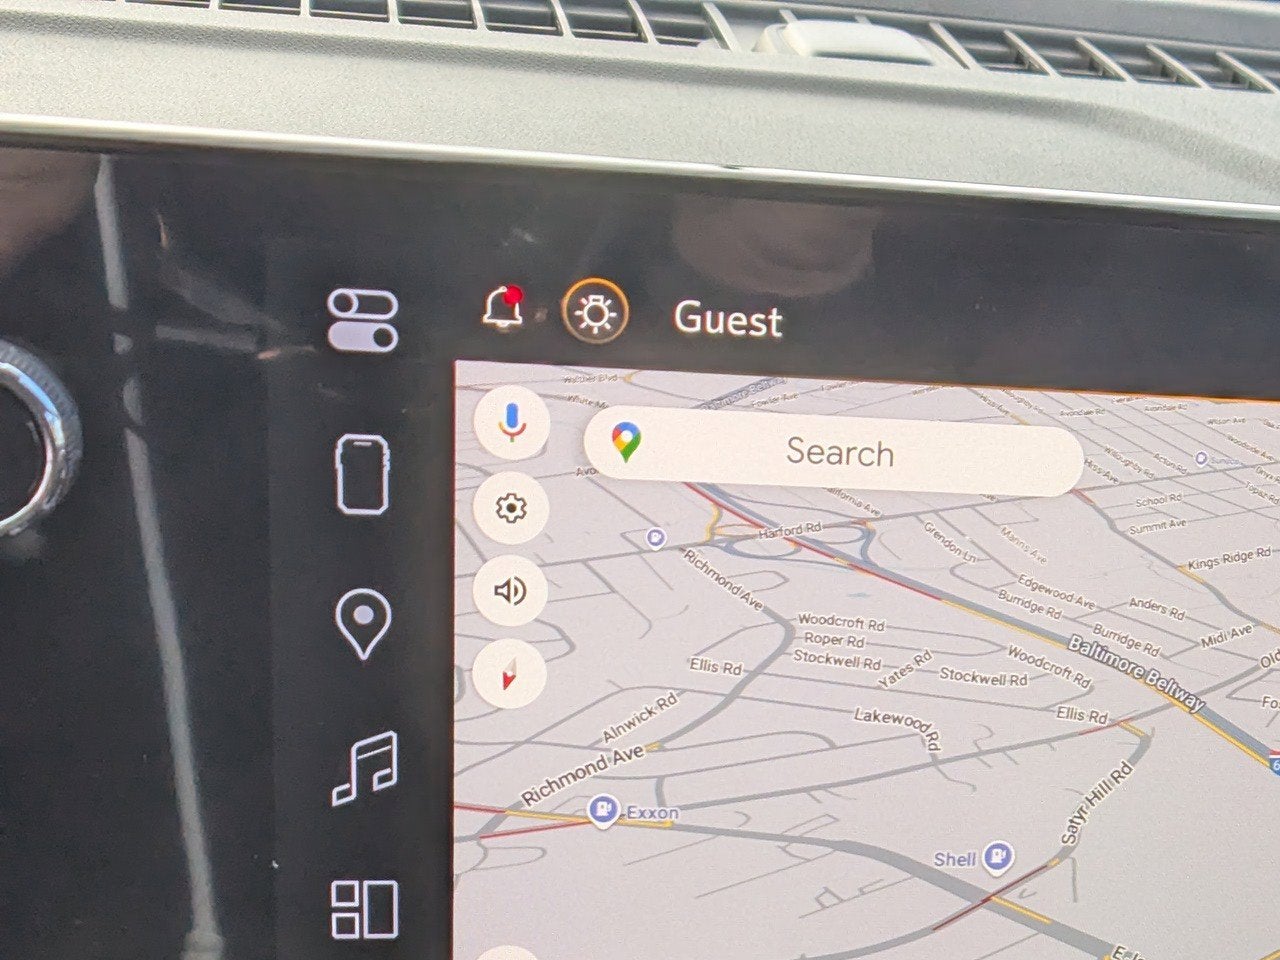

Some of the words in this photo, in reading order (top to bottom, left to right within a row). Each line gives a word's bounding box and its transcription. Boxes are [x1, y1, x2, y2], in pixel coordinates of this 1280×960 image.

[674, 299, 783, 337] Guest
[787, 436, 893, 467] Search
[1143, 469, 1154, 479] Rd
[1176, 466, 1187, 475] Rd
[1136, 496, 1167, 507] School
[1170, 494, 1182, 502] Rd
[1269, 493, 1280, 505] Rd
[759, 524, 803, 539] Harford
[806, 522, 822, 532] Rd
[1130, 523, 1166, 535] Summit
[1169, 519, 1187, 528] Ave
[924, 522, 966, 556] Grendon
[964, 551, 976, 563] Ln
[1030, 549, 1047, 564] Ave
[1188, 559, 1221, 570] Kings
[1223, 552, 1253, 564] Ridge
[1256, 548, 1271, 558] Rd
[684, 549, 741, 595] Richmond
[741, 592, 763, 611] Ave
[1018, 573, 1073, 602] Edgewood
[1075, 596, 1095, 610] Ave
[998, 589, 1044, 614] Burridge
[1046, 607, 1062, 620] Rd
[1130, 598, 1167, 614] Anders
[1170, 608, 1185, 621] Rd
[799, 613, 864, 629] Woodcroft
[869, 620, 885, 631] Rd
[805, 632, 843, 646] Roper
[847, 636, 865, 648] Rd
[1093, 623, 1142, 649] Burridge
[1144, 645, 1160, 657] Rd
[1201, 633, 1228, 648] Midi
[1230, 624, 1253, 638] Ave
[690, 658, 719, 672] Ellis
[723, 663, 742, 676] Rd
[794, 649, 860, 667] Stockwell
[864, 658, 881, 670] Rd
[879, 663, 914, 689] Yates
[914, 650, 932, 666] Rd
[1009, 645, 1072, 680] Woodcroft
[1074, 672, 1091, 689] Rd
[940, 667, 1006, 686] Stockwell
[1010, 674, 1028, 687] Rd
[1069, 633, 1144, 679] Baltimore
[1146, 669, 1206, 713] Beltway
[602, 706, 656, 742] Alnwick
[657, 692, 678, 711] Rd
[1057, 706, 1084, 721] Ellis
[1089, 710, 1108, 724] Rd
[854, 708, 929, 734] Lakewood
[926, 731, 940, 751] Rd
[521, 755, 608, 806] Richmond
[612, 746, 644, 765] Ave
[628, 806, 679, 819] Exxon
[1062, 805, 1088, 844] Satyr
[1085, 779, 1113, 807] Hill
[1110, 761, 1133, 784] Rd
[934, 853, 976, 867] Shell
[1113, 946, 1126, 960] E
